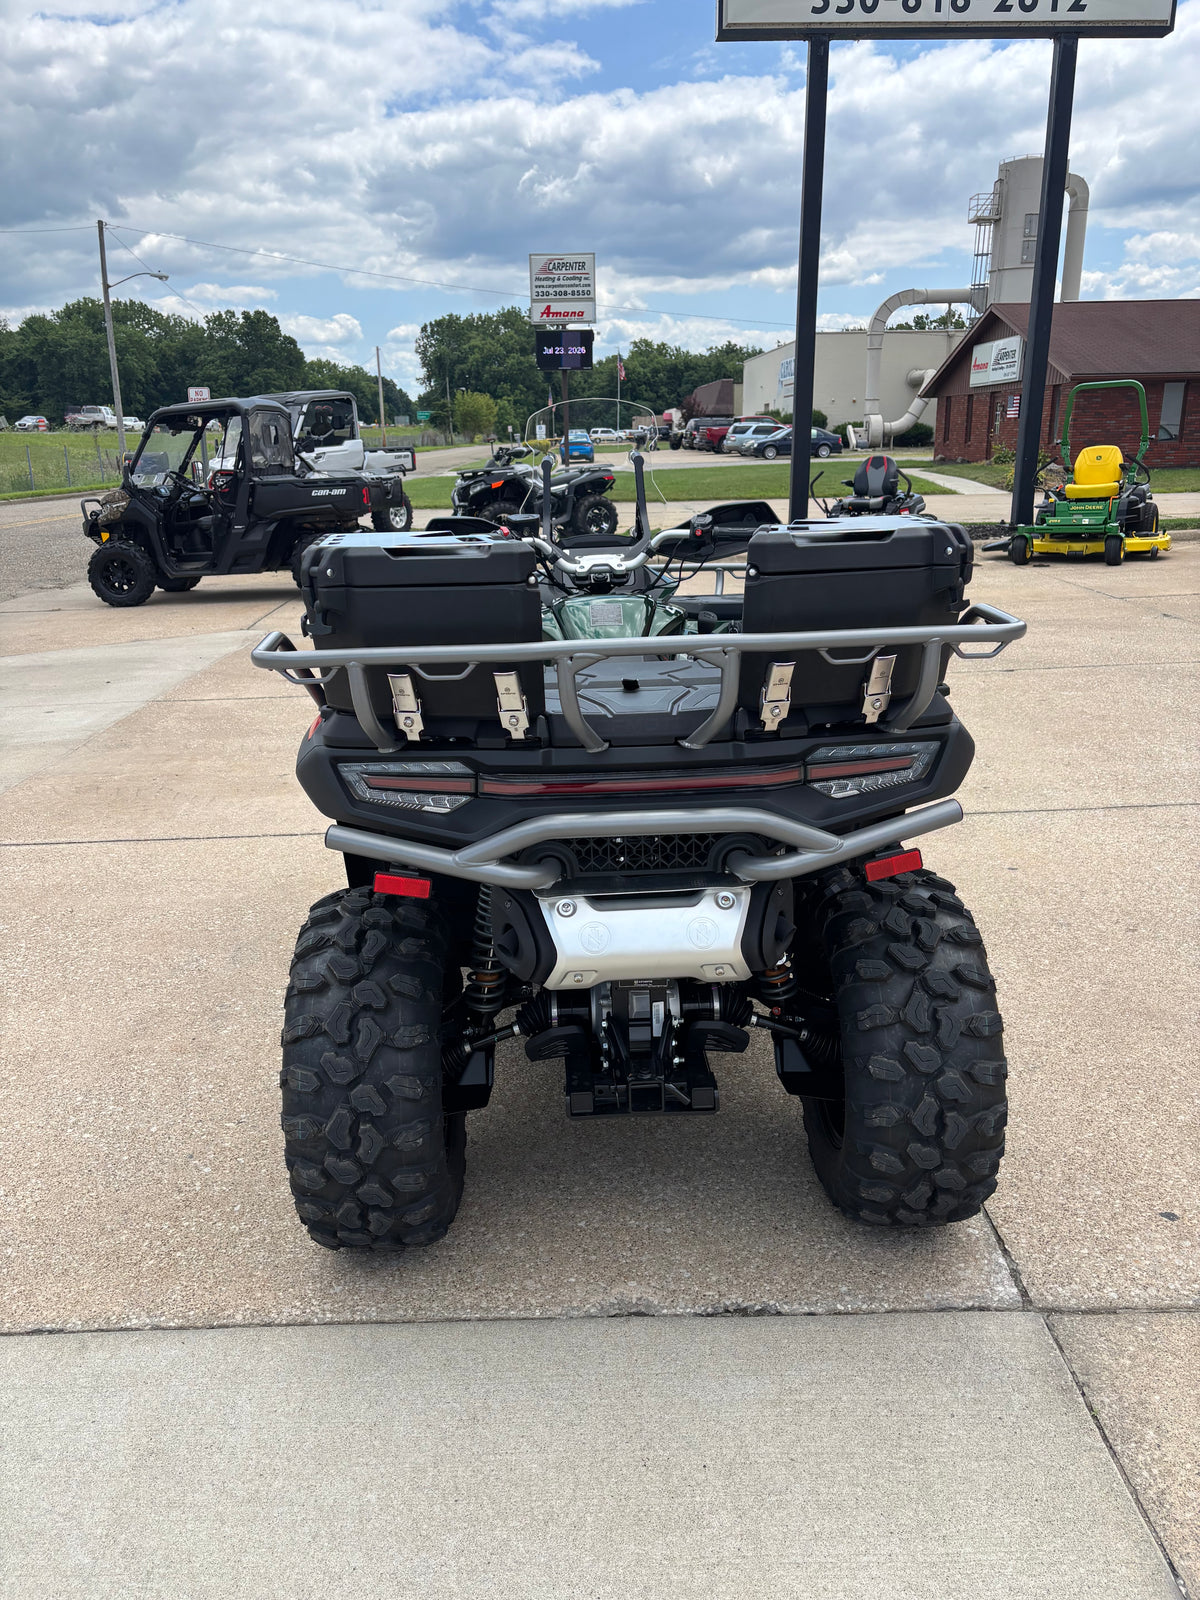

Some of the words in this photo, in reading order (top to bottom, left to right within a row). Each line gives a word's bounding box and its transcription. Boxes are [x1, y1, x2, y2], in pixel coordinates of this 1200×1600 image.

[547, 261, 586, 272] CARPENTER
[534, 275, 556, 283] Heating
[535, 289, 591, 297] 330-308-8550
[540, 304, 585, 318] Amana
[542, 346, 553, 354] Jul
[567, 346, 586, 354] 2026
[311, 488, 347, 496] can-am
